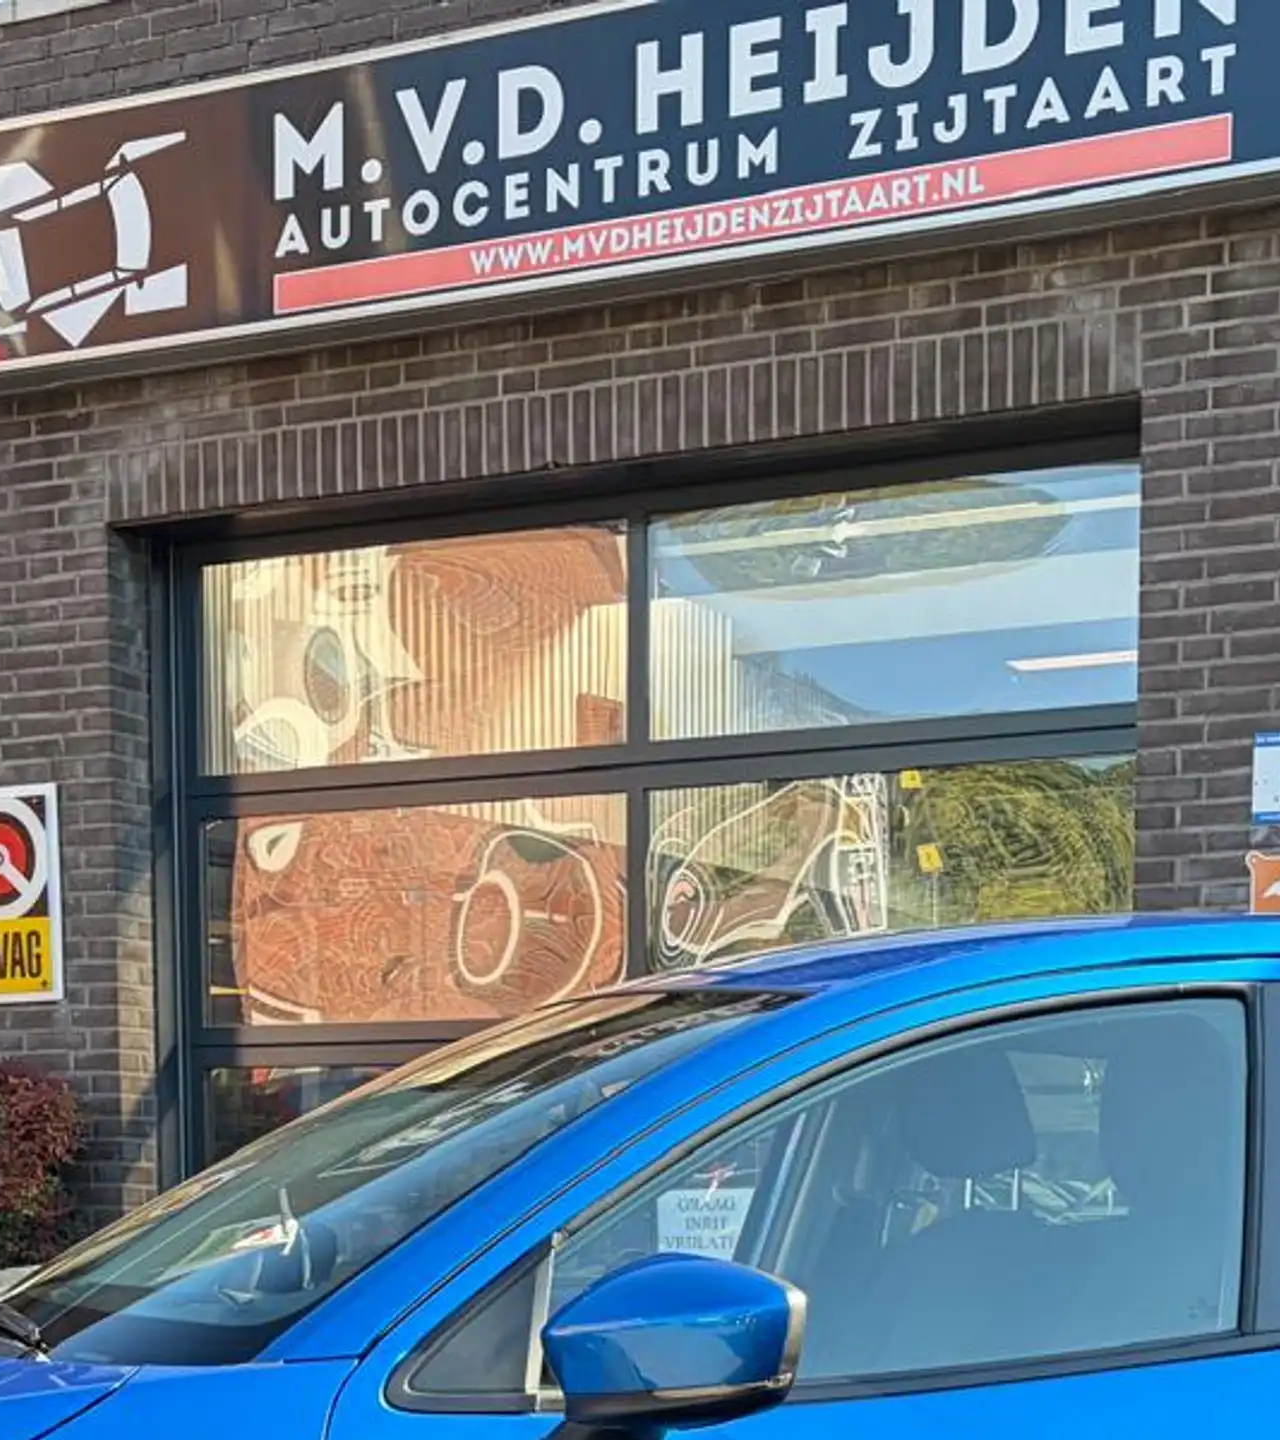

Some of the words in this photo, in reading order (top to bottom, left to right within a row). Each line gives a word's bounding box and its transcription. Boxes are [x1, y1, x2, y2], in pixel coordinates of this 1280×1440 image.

[275, 126, 778, 258] AUTOCENTRUM
[847, 45, 1236, 160] ZIJTAART
[469, 168, 984, 276] WWW.MVDHEIJDENZIJTAART.NL
